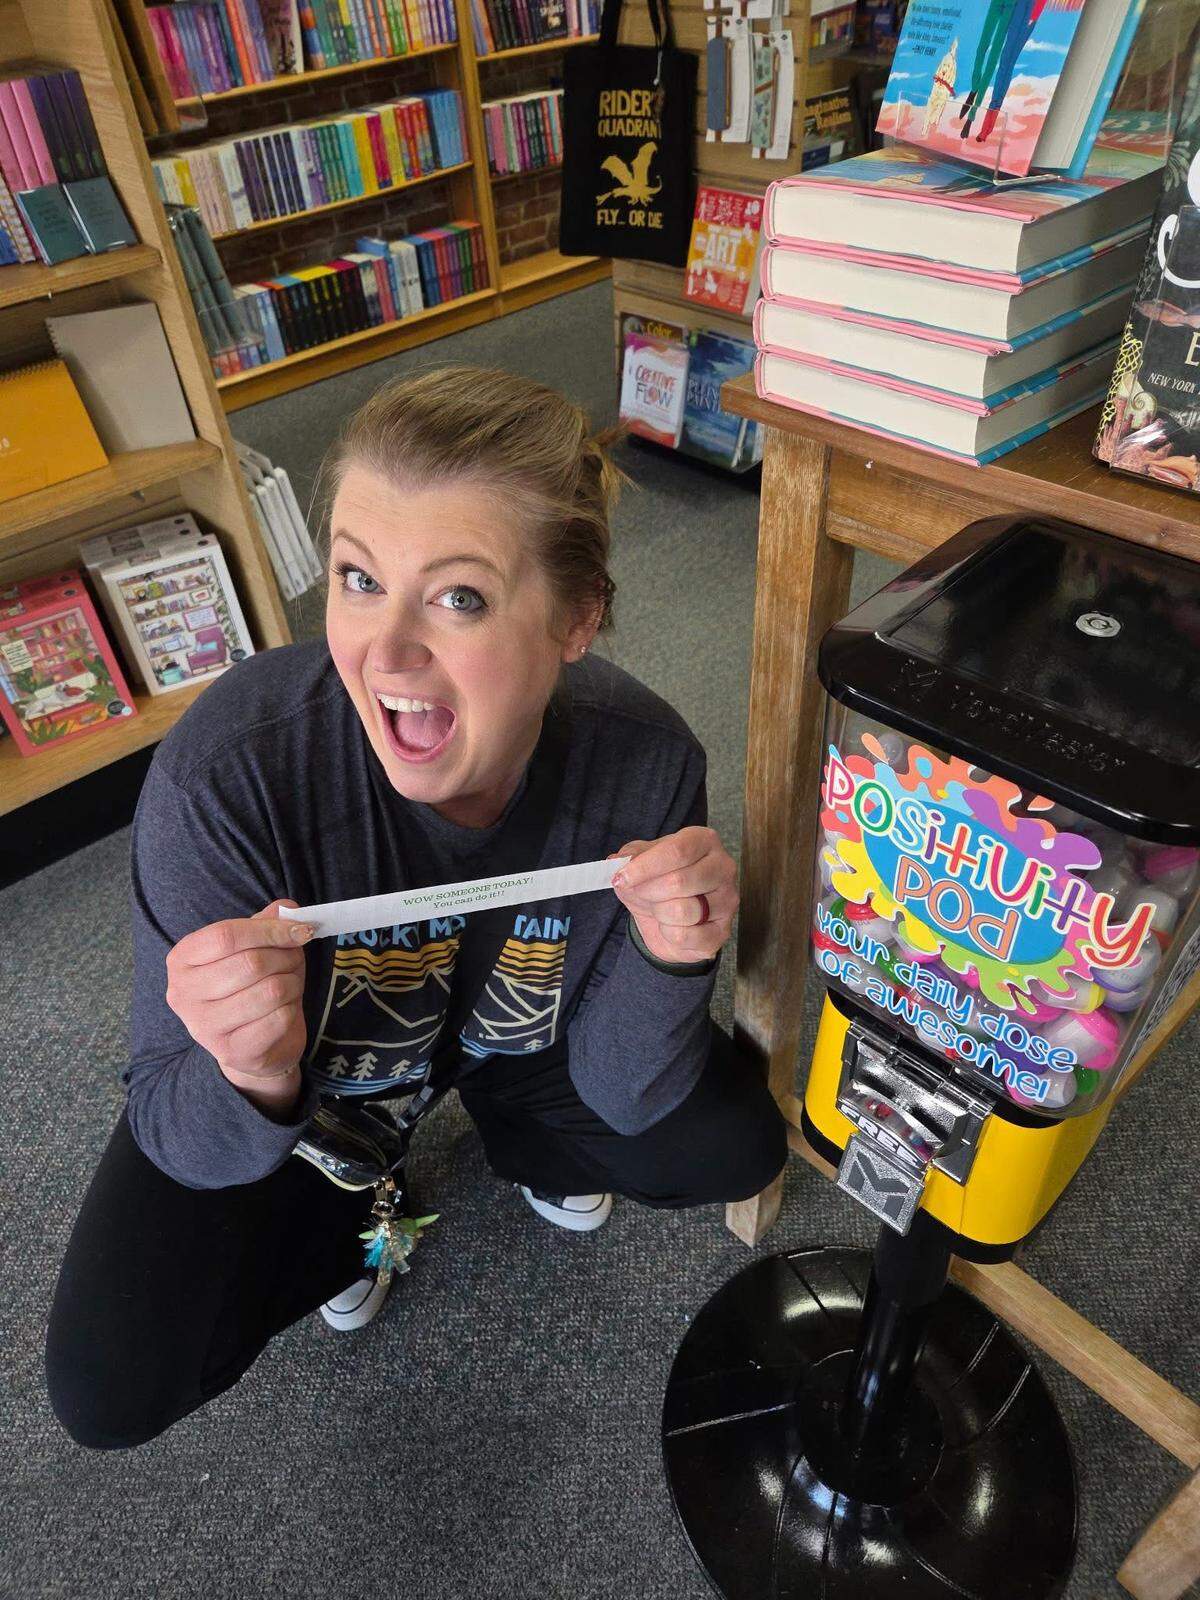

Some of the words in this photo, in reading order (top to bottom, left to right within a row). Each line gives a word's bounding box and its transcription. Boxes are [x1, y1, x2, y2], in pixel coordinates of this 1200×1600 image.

[599, 89, 654, 117] RIDER
[629, 210, 645, 227] OR
[703, 224, 742, 272] ART
[635, 382, 674, 408] FLOW
[1147, 372, 1171, 387] NEW
[1171, 378, 1197, 394] YORK
[403, 894, 434, 906] WOW
[436, 884, 491, 901] SOMEONE
[493, 876, 535, 890] TODAY!
[433, 900, 453, 909] You
[455, 897, 473, 905] can
[817, 903, 889, 965] your
[894, 961, 974, 1024] daily
[979, 1007, 1078, 1073] dose
[839, 1103, 922, 1170] FREE
